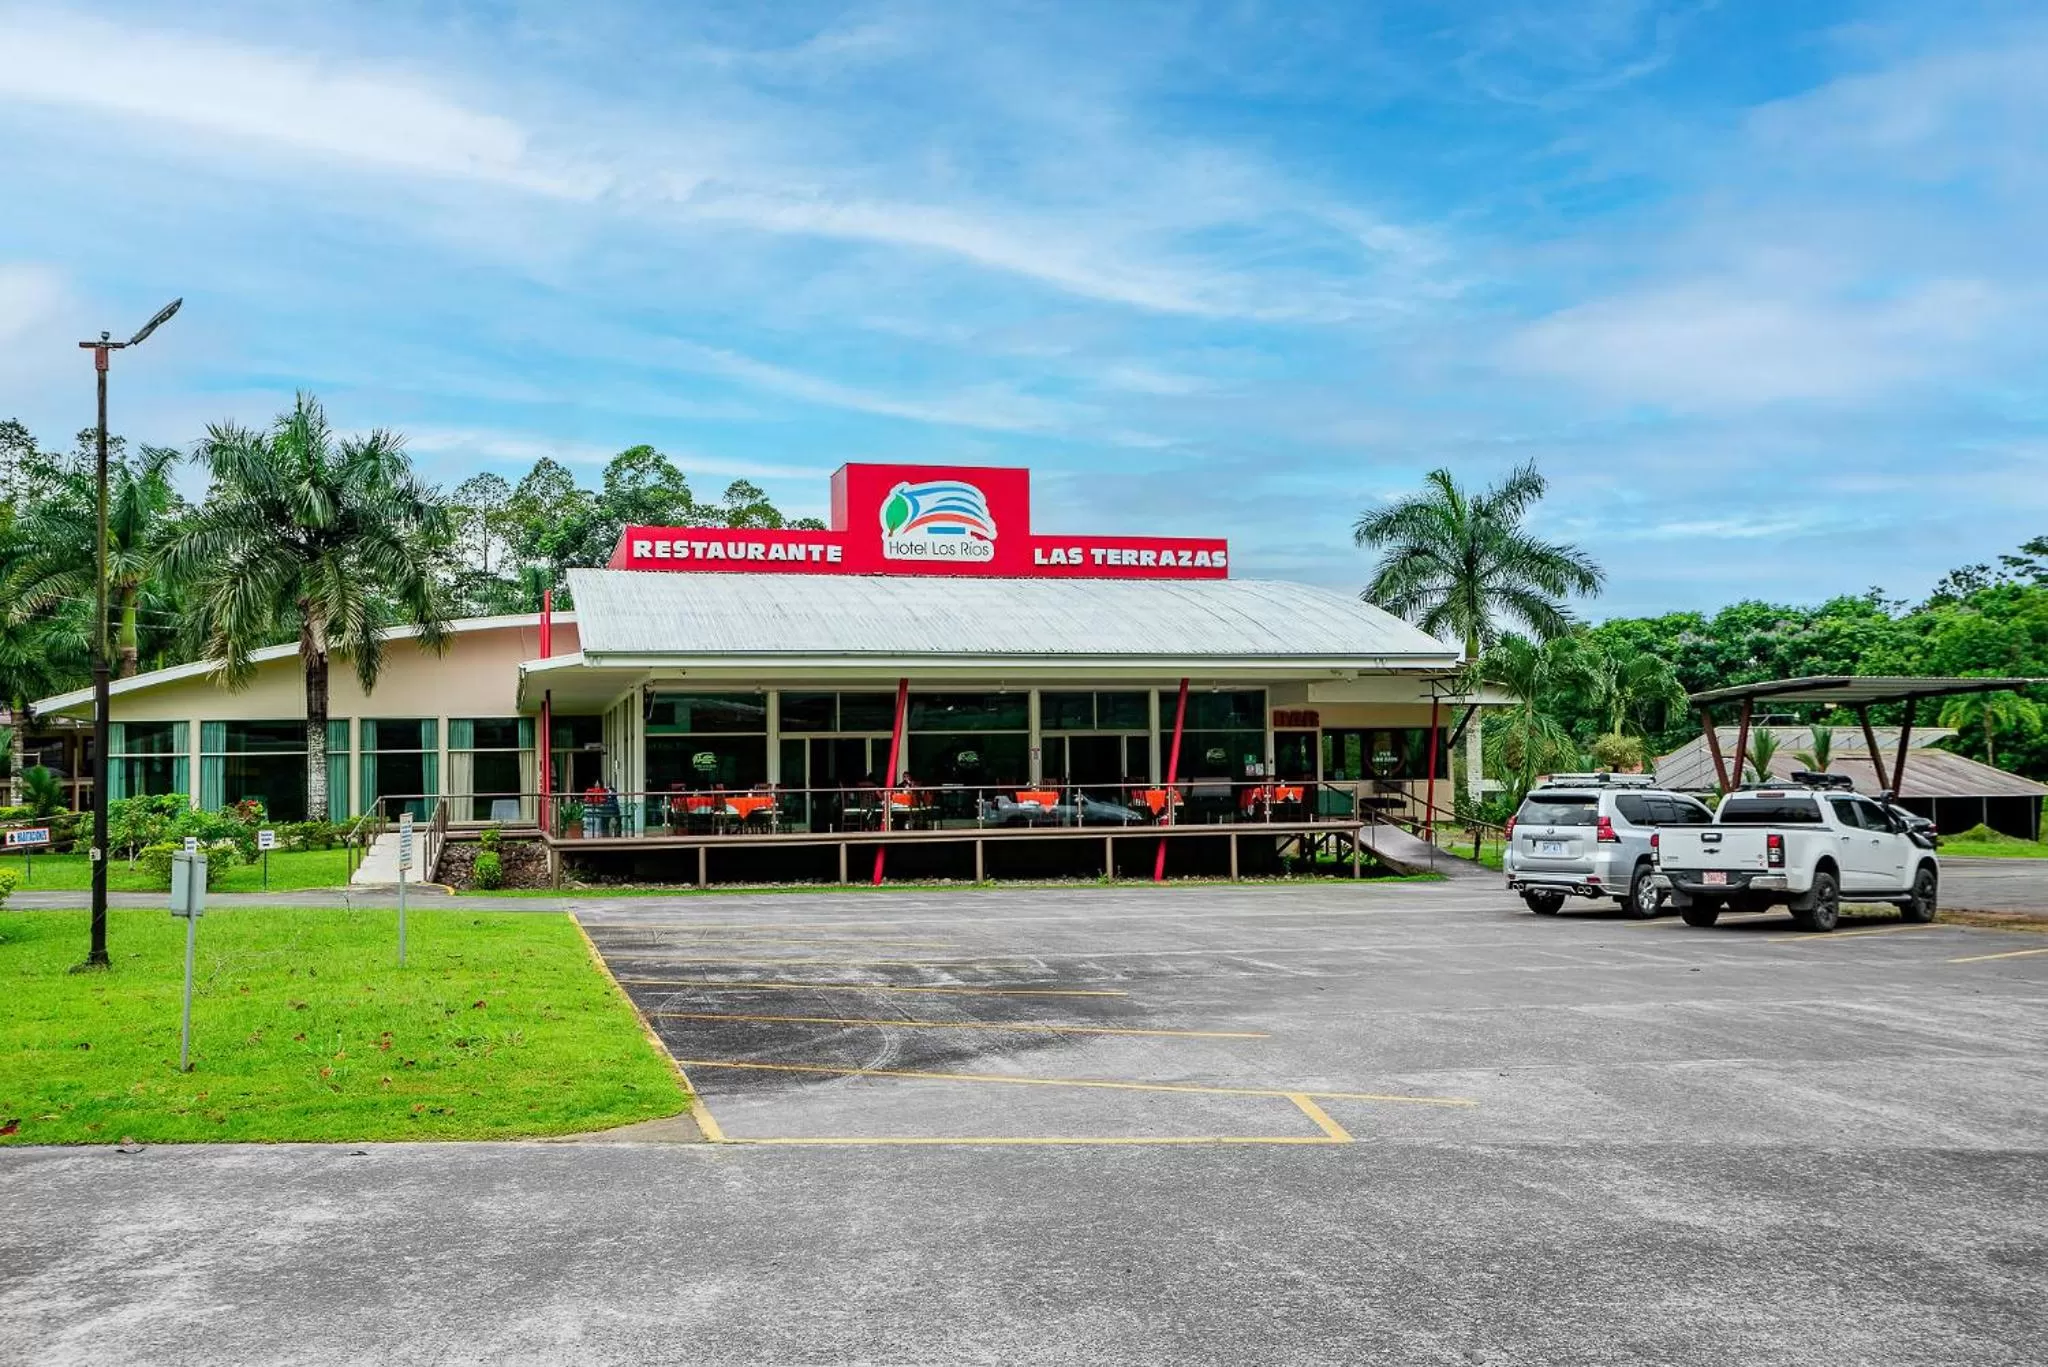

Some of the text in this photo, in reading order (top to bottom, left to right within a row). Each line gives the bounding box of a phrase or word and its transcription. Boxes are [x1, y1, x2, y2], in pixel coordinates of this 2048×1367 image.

[632, 540, 842, 562] RESTAURANTE
[889, 541, 928, 555] Hotel
[932, 541, 956, 556] Los
[1034, 547, 1227, 568] LAS TERRAZAS
